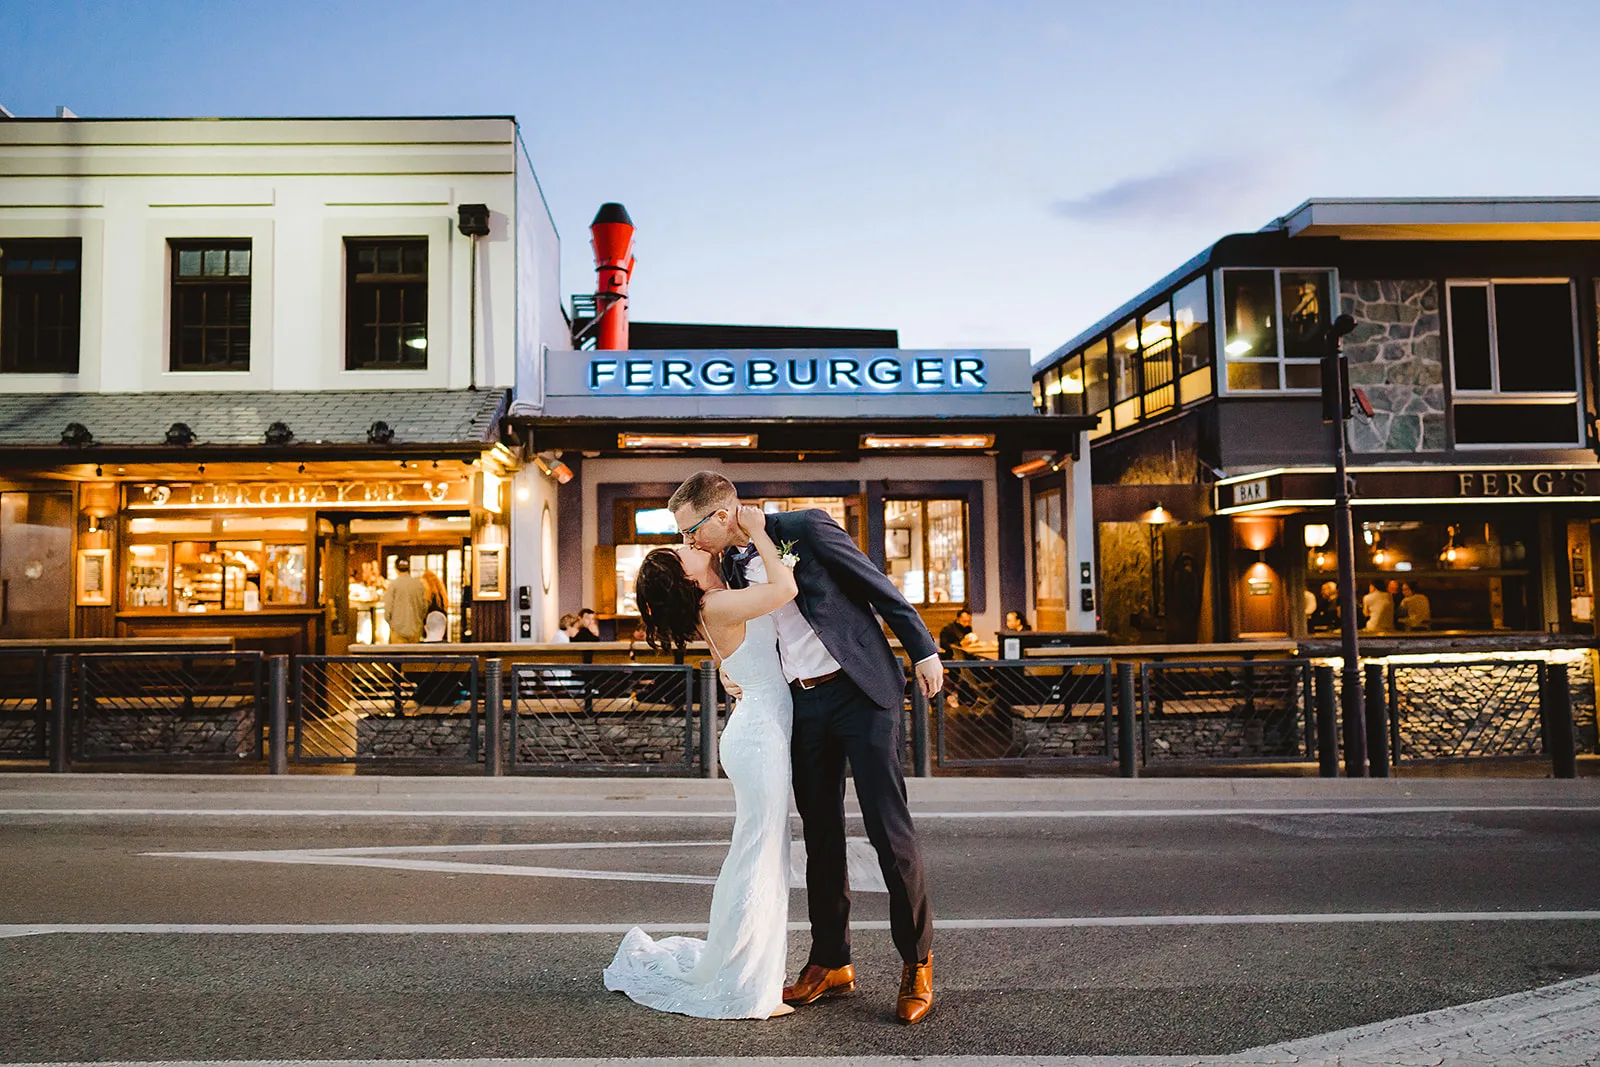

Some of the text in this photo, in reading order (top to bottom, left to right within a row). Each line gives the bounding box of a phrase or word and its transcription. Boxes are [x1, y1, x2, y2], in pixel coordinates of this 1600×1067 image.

[590, 359, 987, 391] FERGBURGER
[1240, 483, 1262, 501] BAR
[1458, 472, 1588, 496] FERG'S
